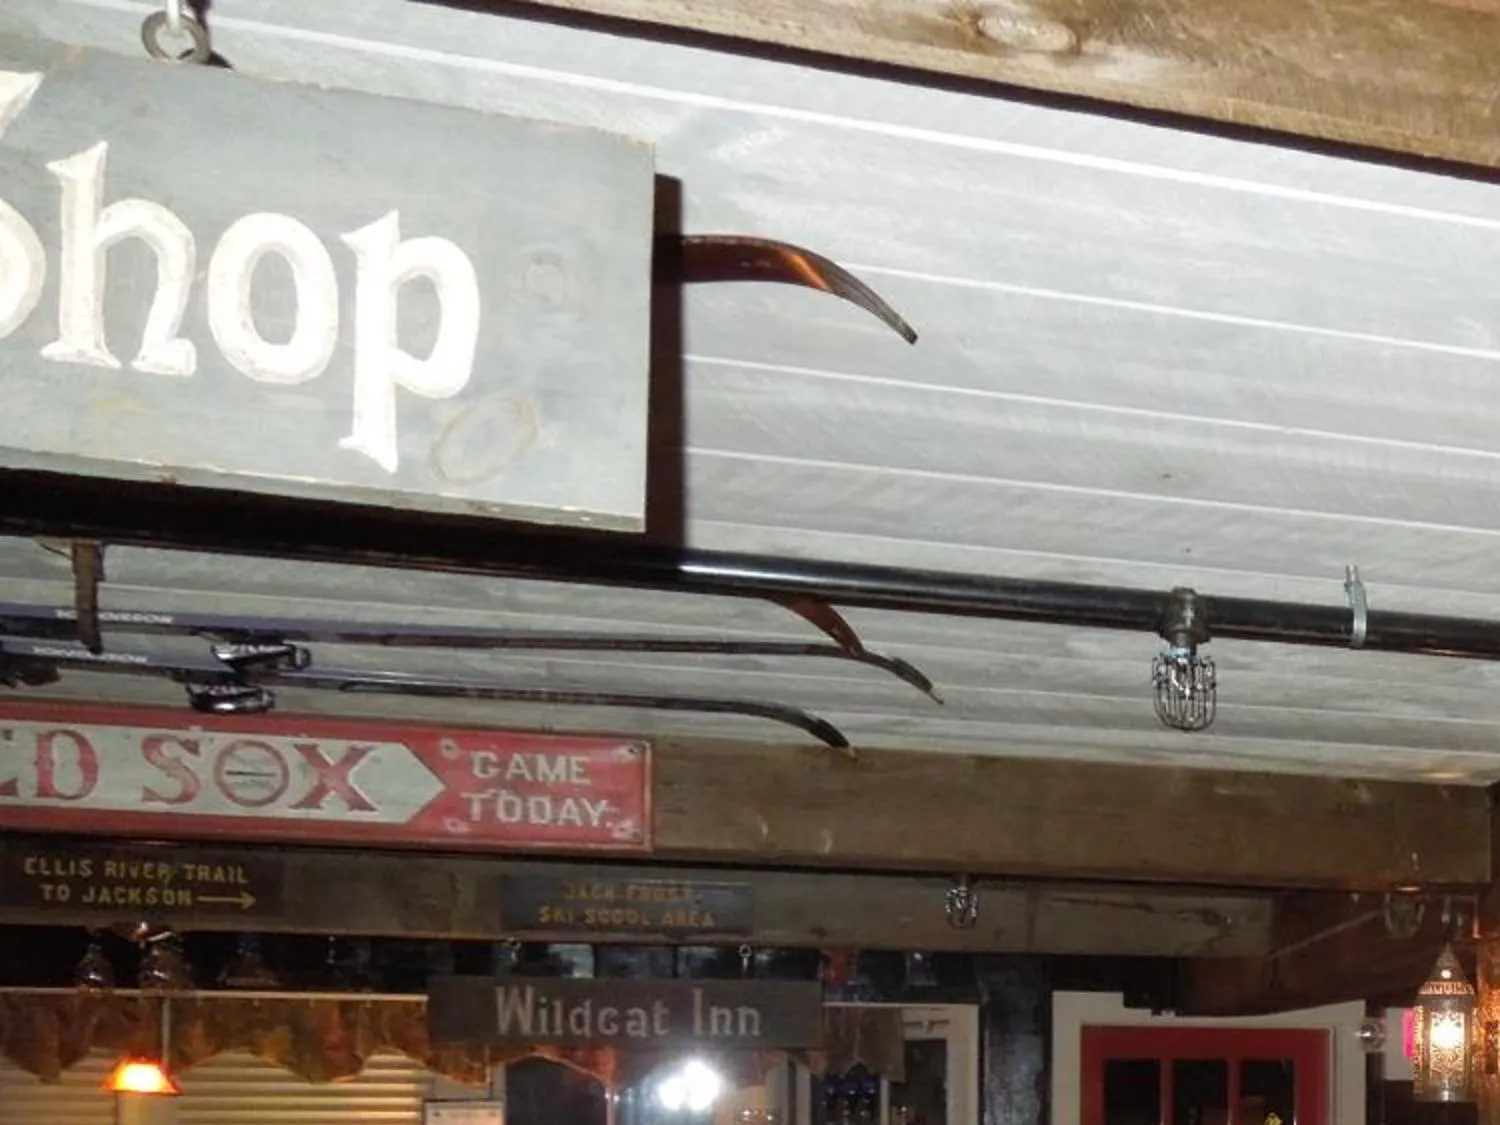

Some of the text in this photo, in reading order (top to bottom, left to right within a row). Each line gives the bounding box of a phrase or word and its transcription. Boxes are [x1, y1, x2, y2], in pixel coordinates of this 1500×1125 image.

[0, 729, 378, 813] D SOX
[471, 750, 592, 785] GAME
[24, 856, 249, 885] ELLIS RIVER TRAIL
[40, 885, 193, 907] TO JACKSON
[496, 984, 762, 1038] Wildcat Inn
